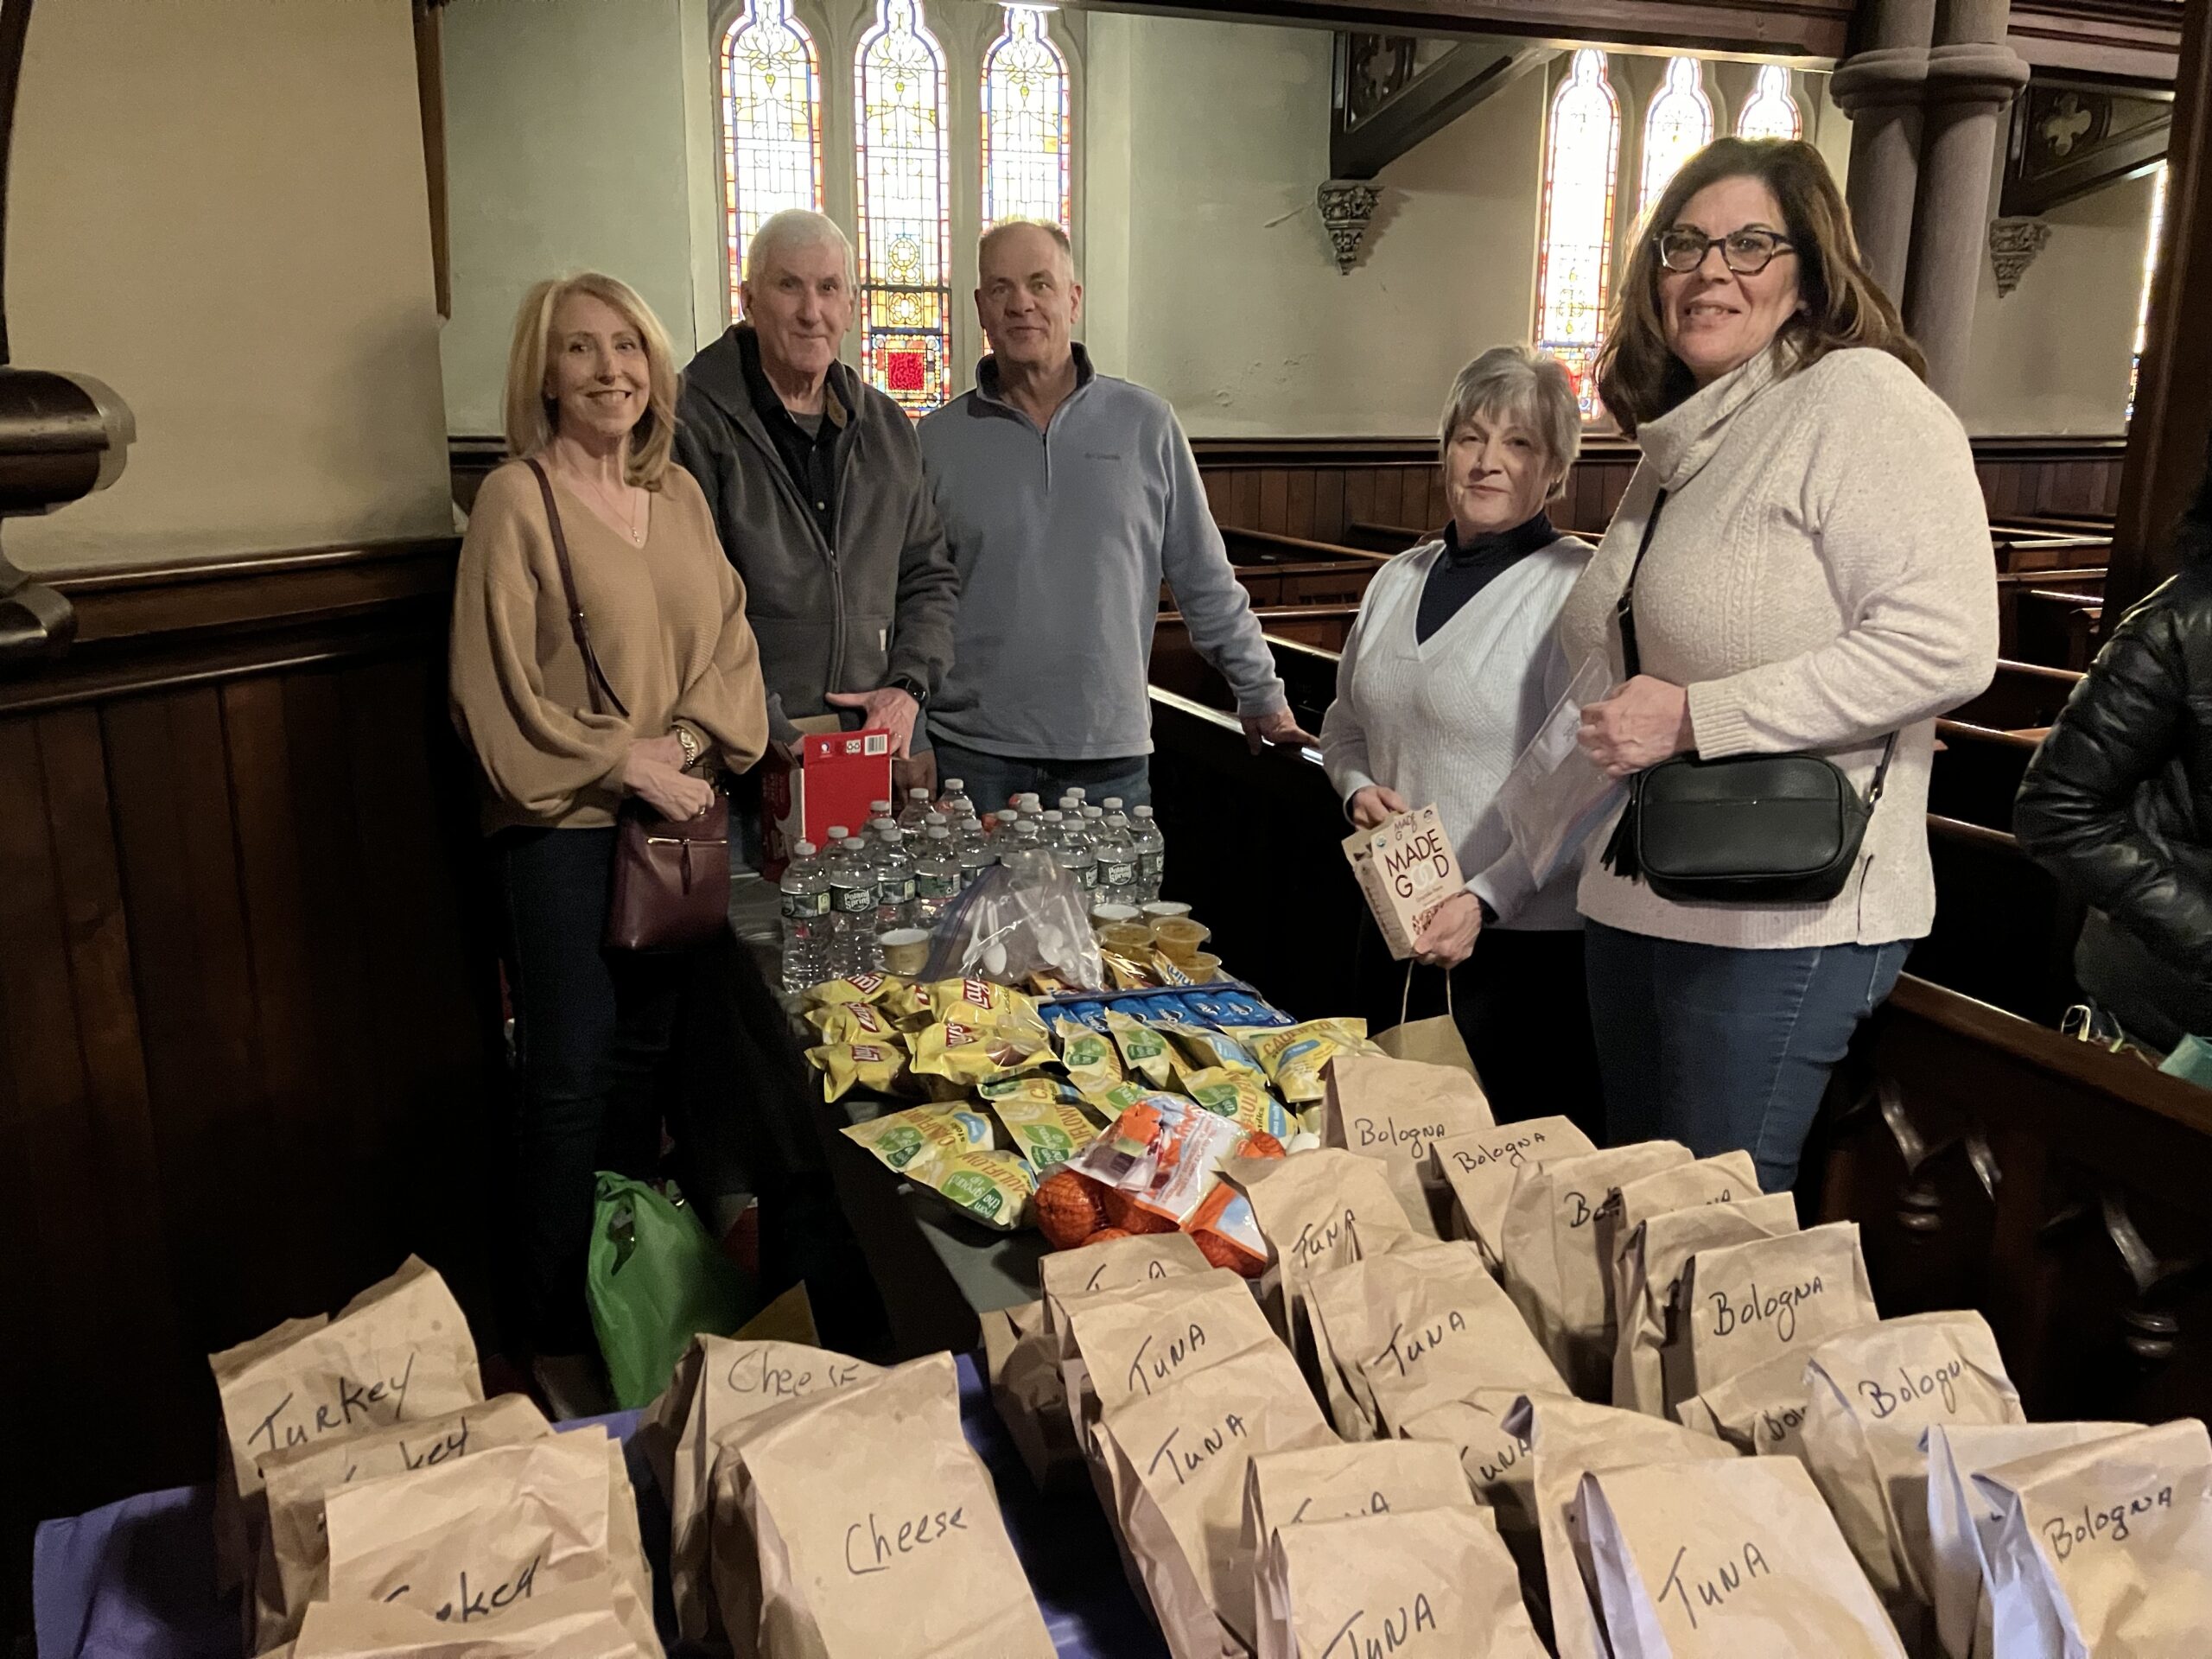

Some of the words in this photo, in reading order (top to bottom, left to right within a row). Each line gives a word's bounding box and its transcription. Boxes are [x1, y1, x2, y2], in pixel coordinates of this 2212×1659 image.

[1394, 811, 1417, 832] MADE
[1383, 828, 1443, 878] MADE
[844, 890, 869, 901] Poland
[845, 896, 870, 911] Spring
[947, 1174, 986, 1198] ground
[982, 1194, 1001, 1210] the
